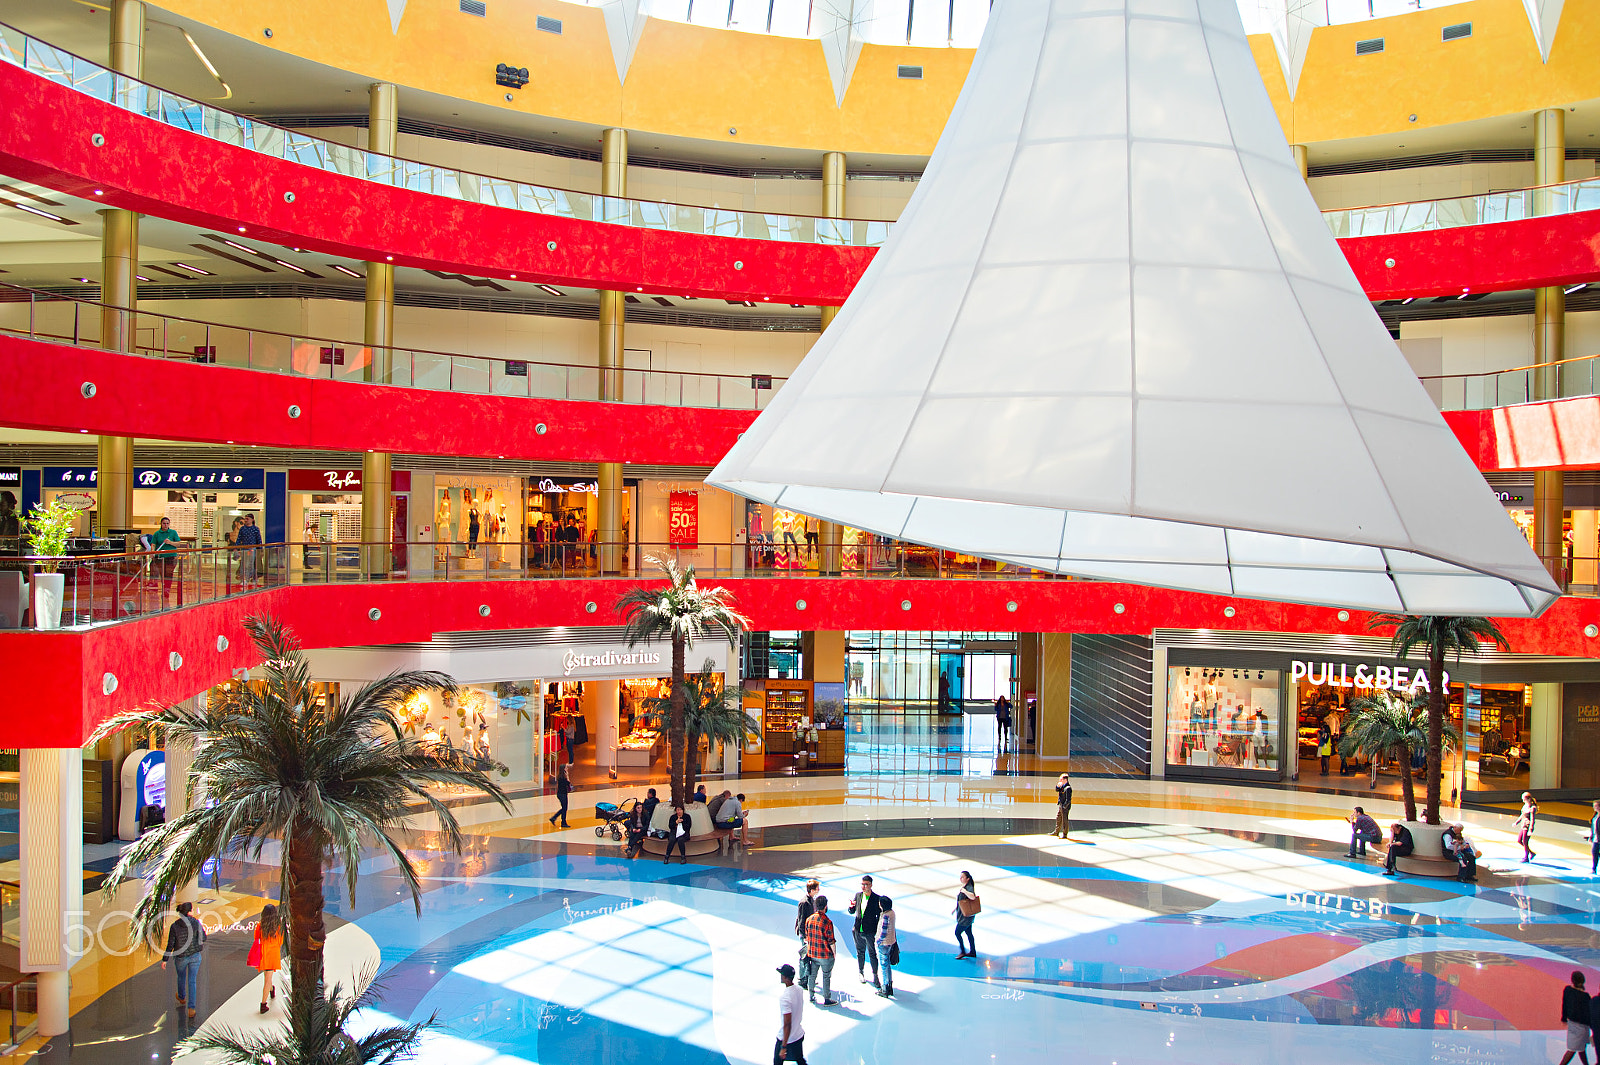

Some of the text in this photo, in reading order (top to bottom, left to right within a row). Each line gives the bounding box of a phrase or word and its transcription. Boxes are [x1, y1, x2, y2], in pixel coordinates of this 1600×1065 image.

[167, 472, 243, 483] Roniko
[323, 471, 361, 489] Ray-Ban
[670, 528, 696, 539] SALE
[566, 649, 660, 668] stradivarius
